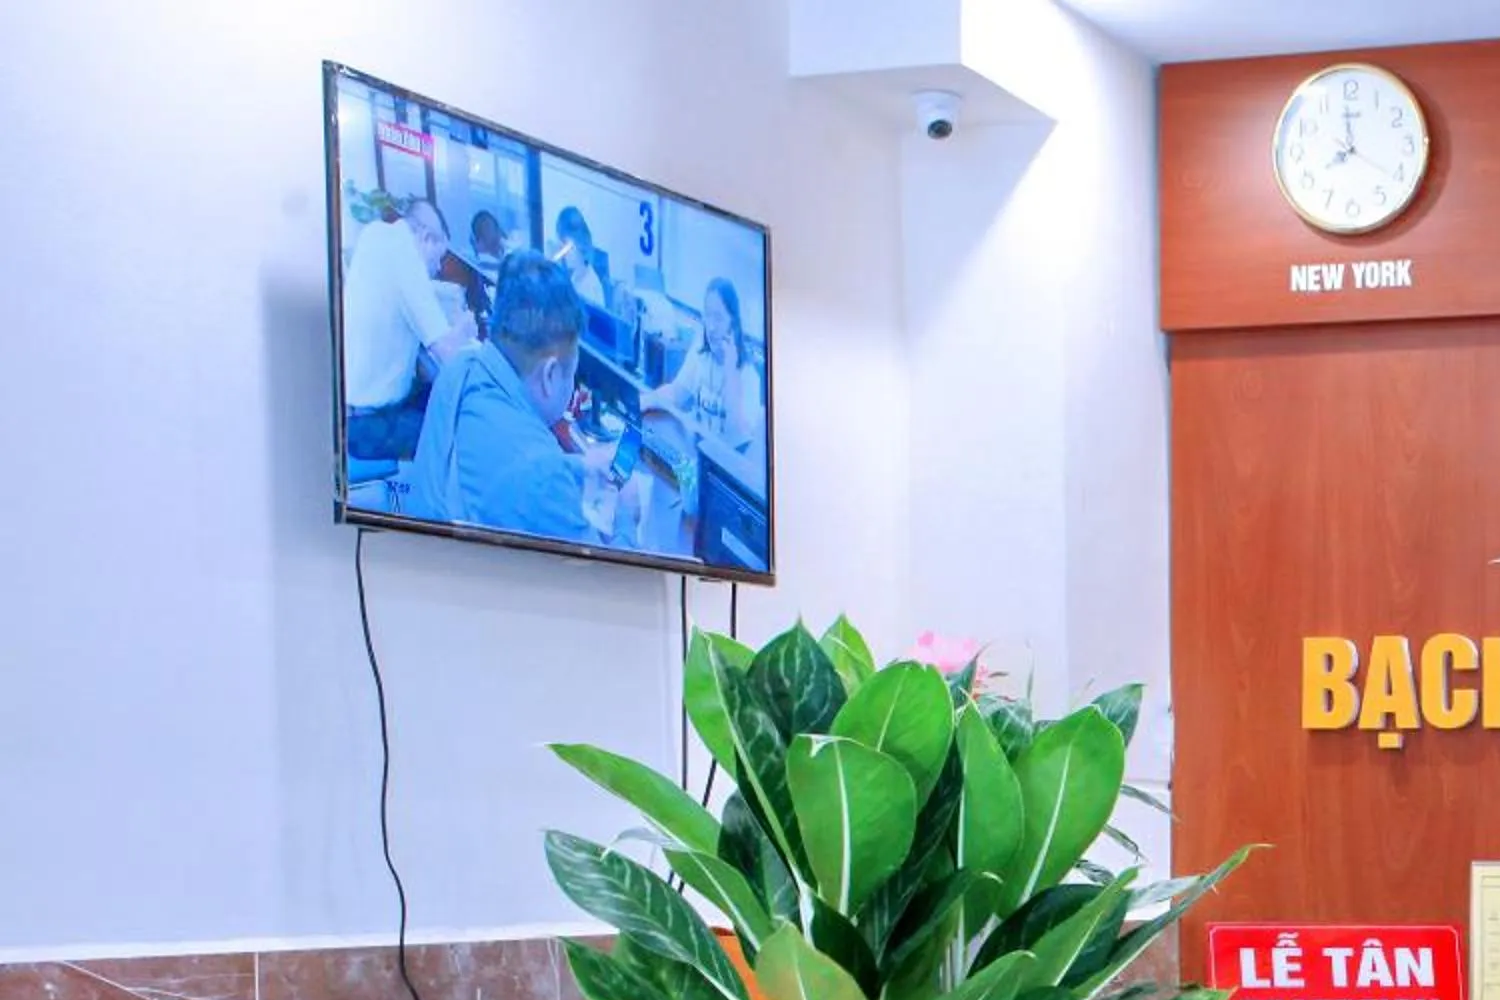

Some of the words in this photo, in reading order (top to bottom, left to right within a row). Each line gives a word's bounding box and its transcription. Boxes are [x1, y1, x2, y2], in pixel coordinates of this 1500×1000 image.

[640, 201, 654, 256] 3
[1290, 263, 1345, 292] NEW
[1351, 259, 1413, 289] YORK
[1239, 931, 1306, 989] LỄ
[1323, 937, 1435, 989] TÂN
